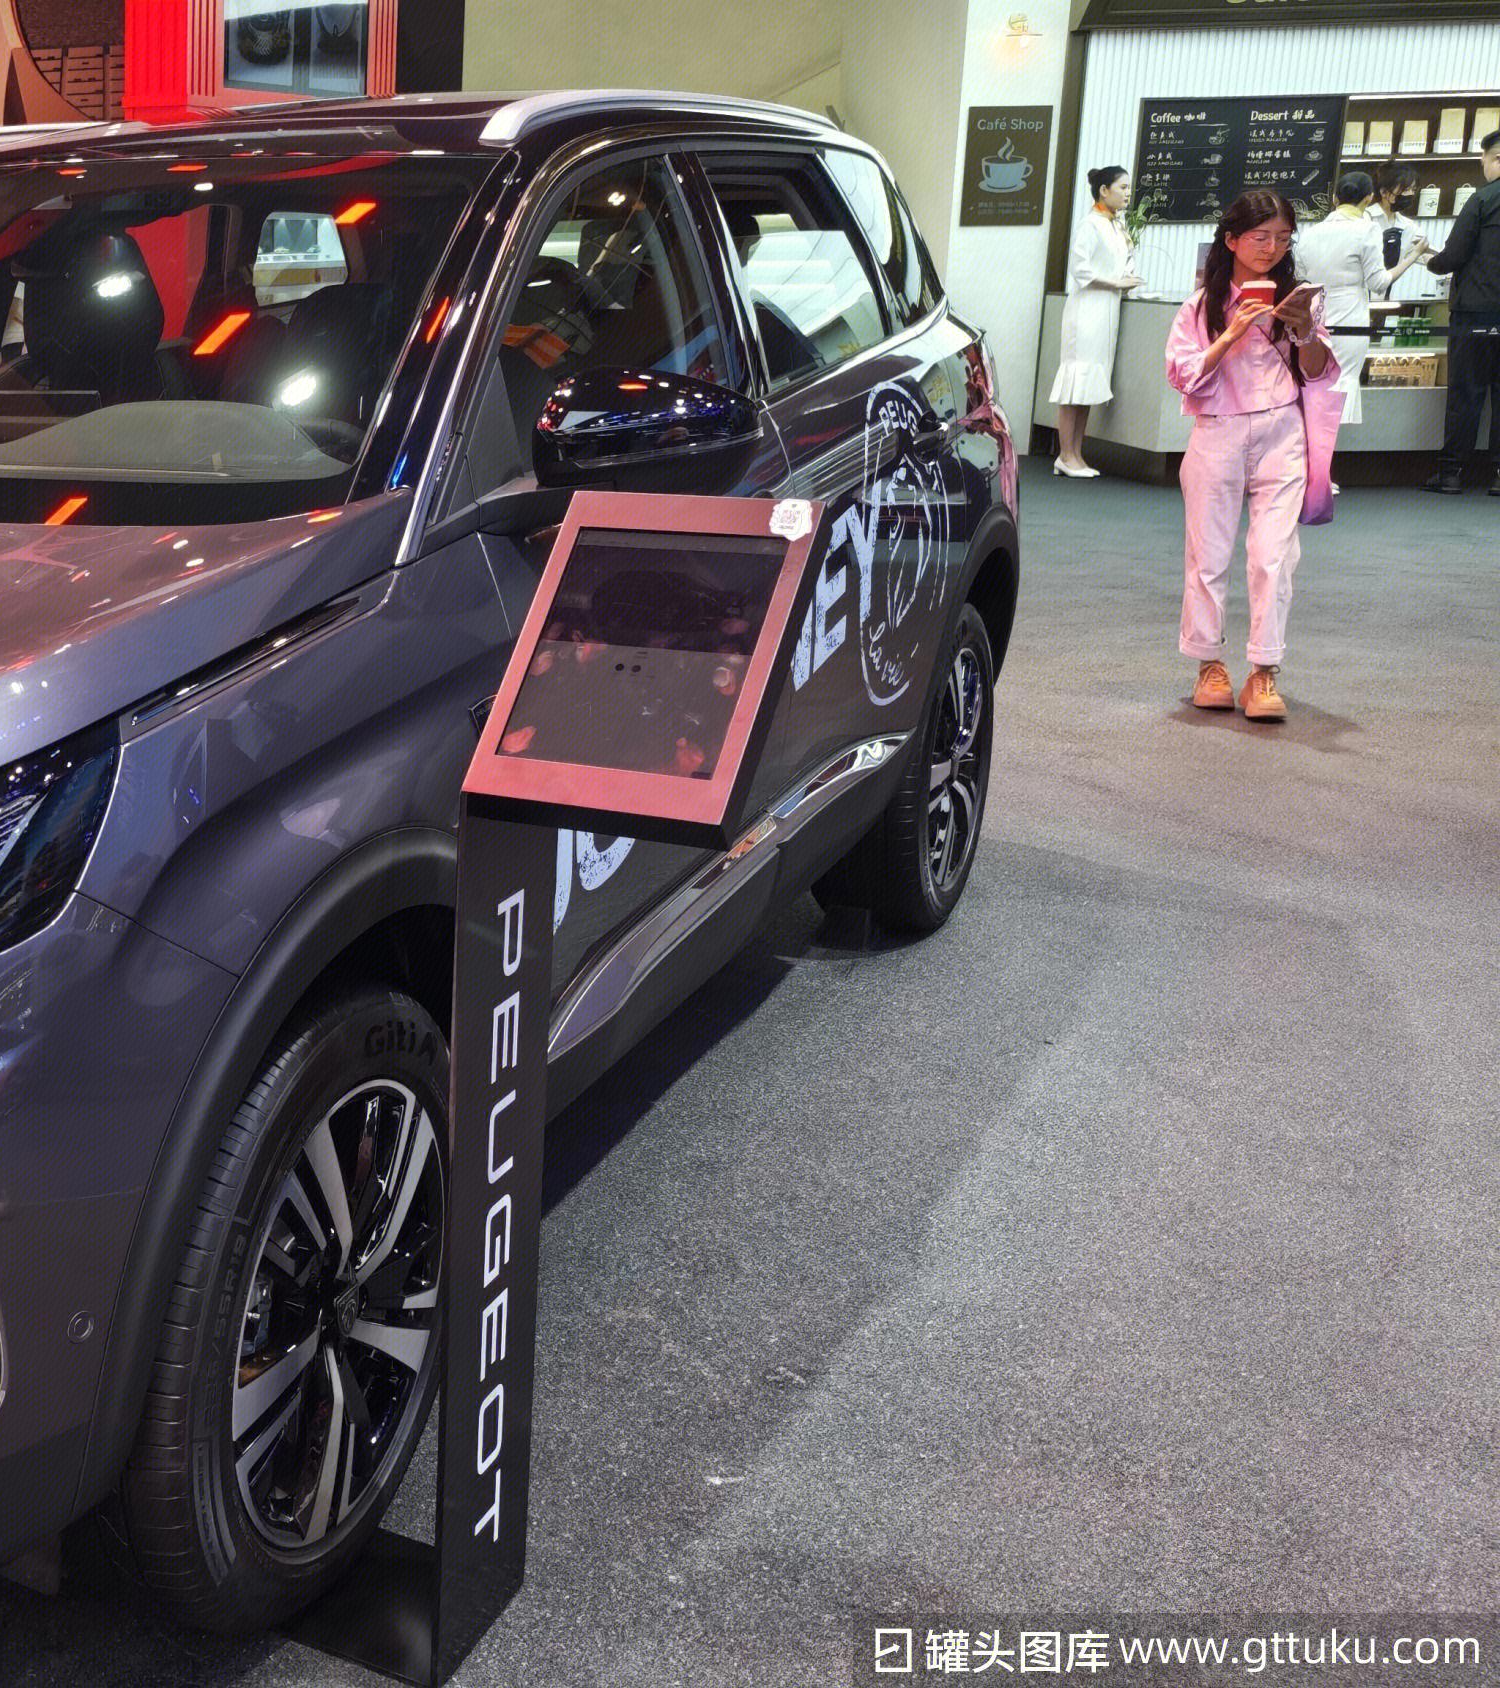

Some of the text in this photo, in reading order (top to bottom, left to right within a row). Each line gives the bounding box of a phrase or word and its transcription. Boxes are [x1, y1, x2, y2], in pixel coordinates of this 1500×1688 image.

[1151, 112, 1181, 123] Coffee
[1250, 110, 1289, 121] Dessert
[977, 117, 1044, 132] Café Shop
[473, 888, 525, 1543] PEUGEOT
